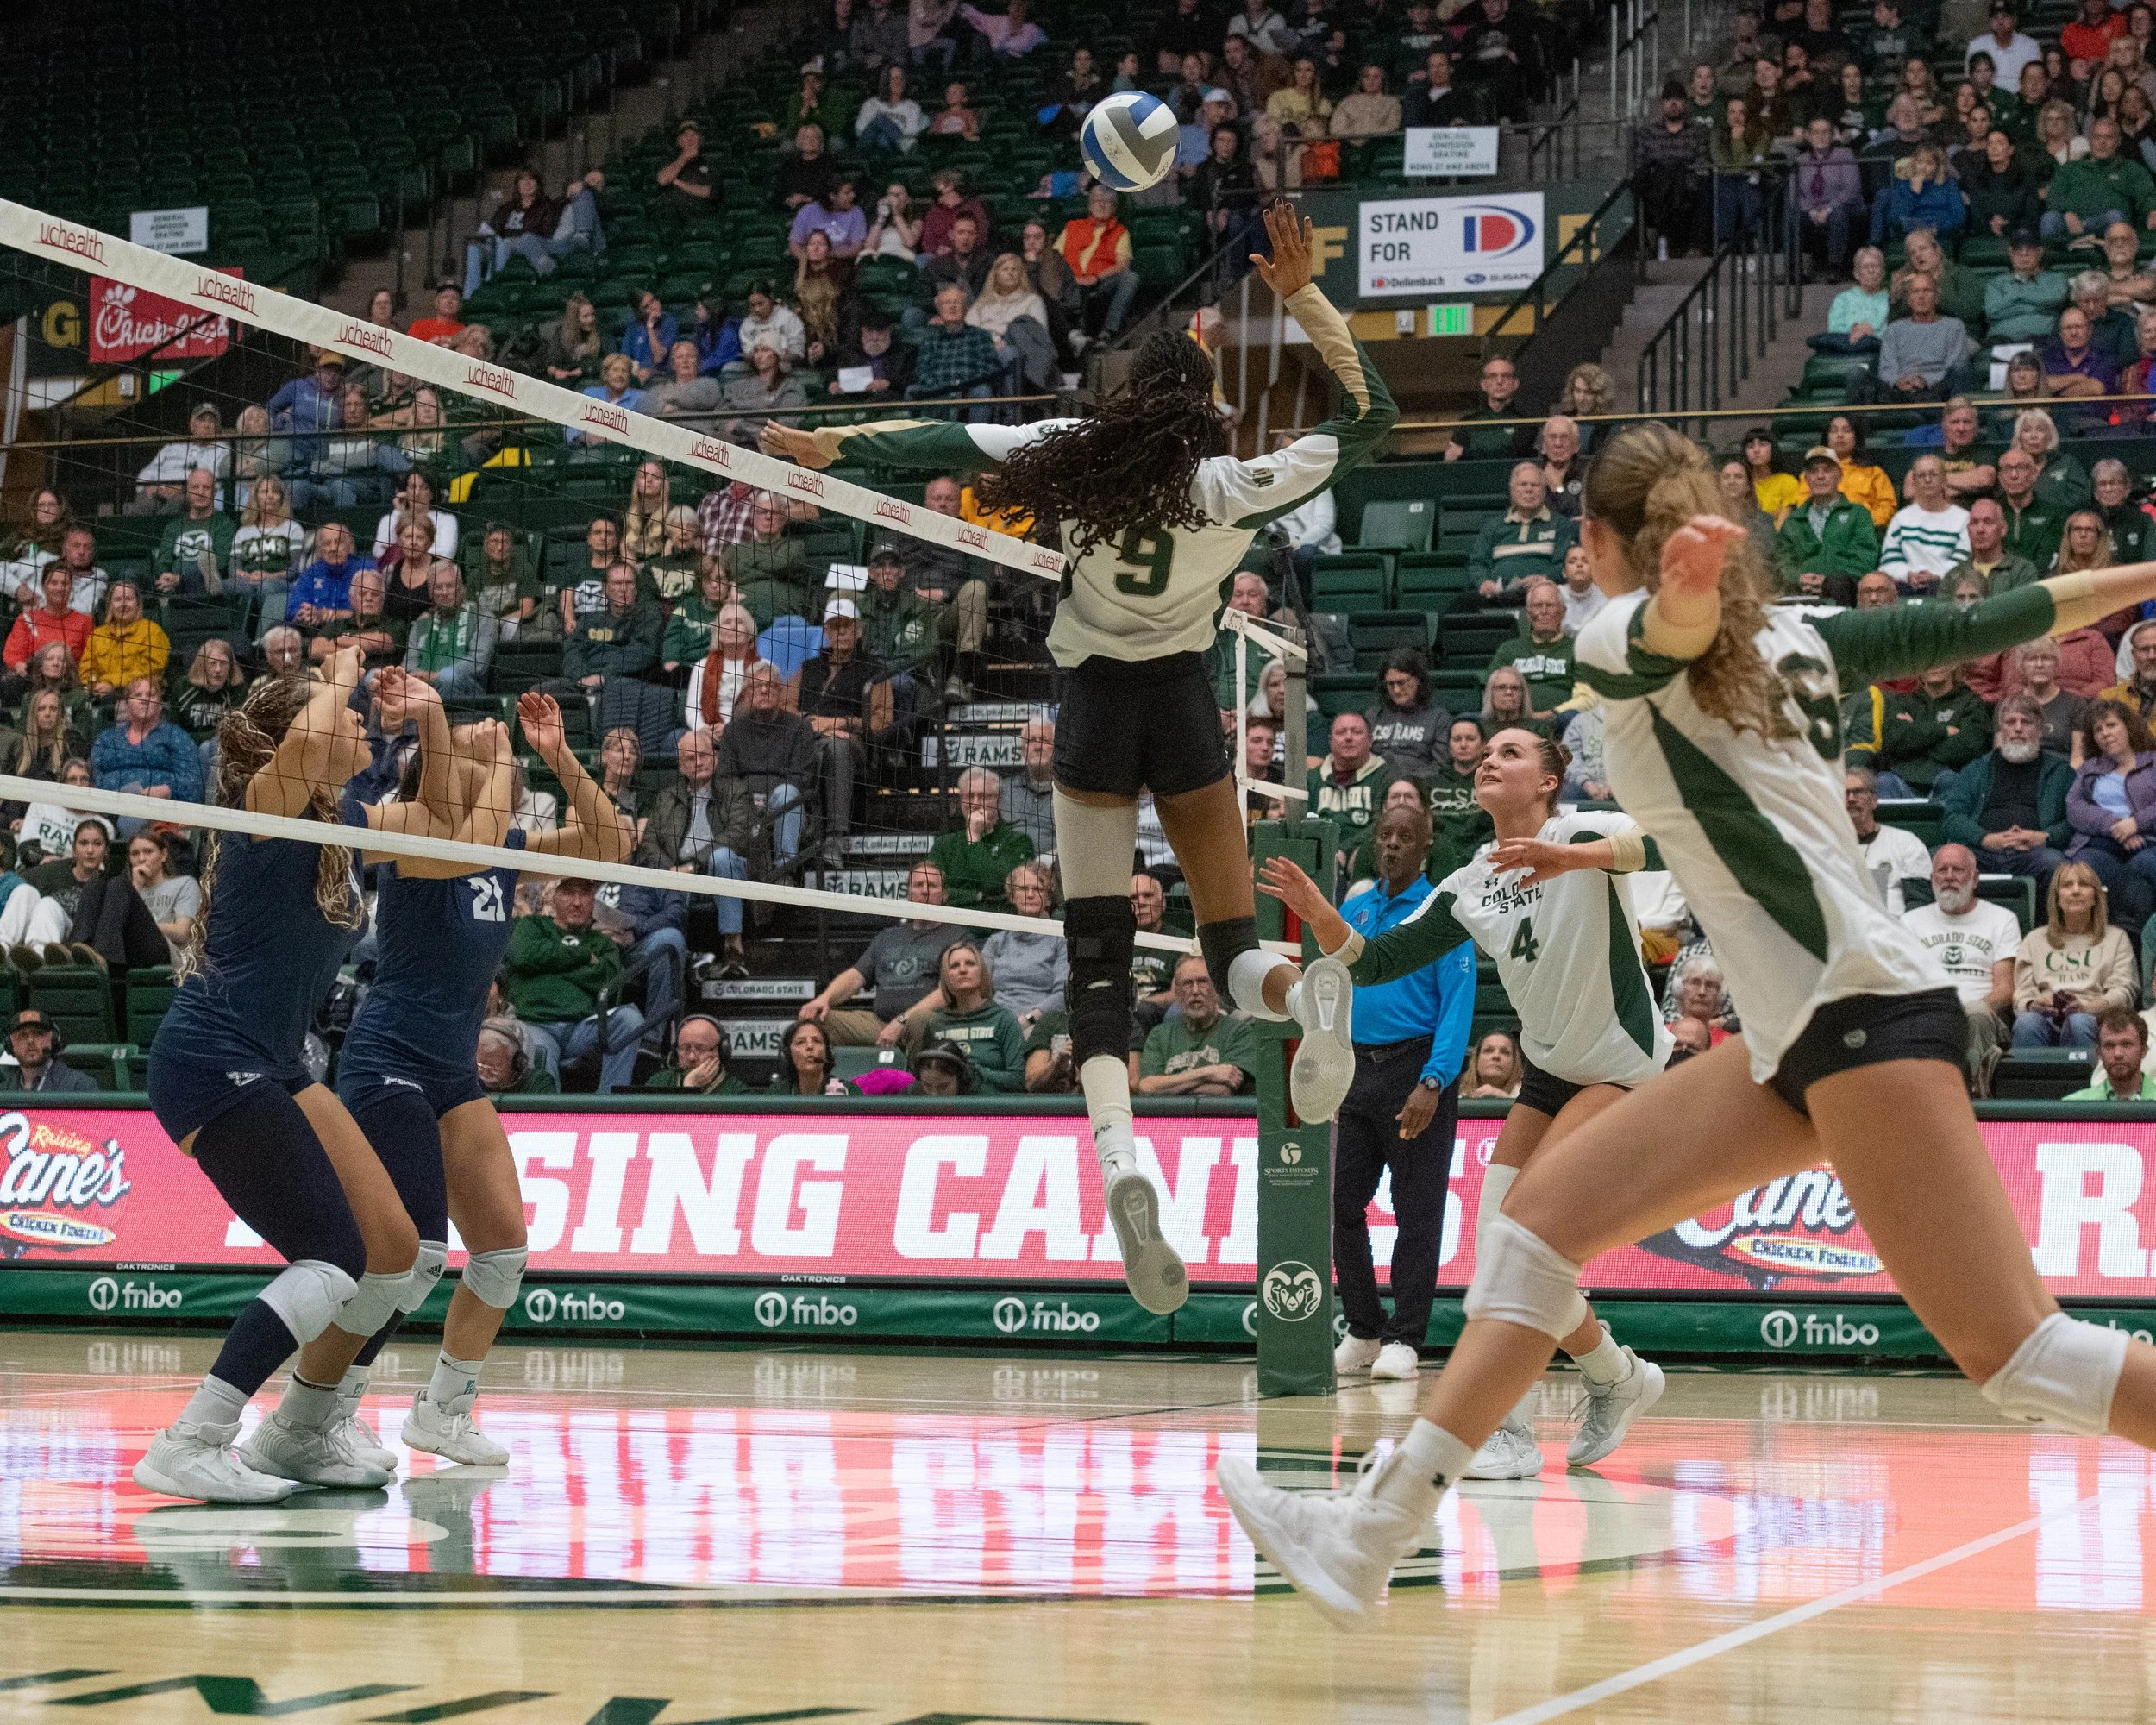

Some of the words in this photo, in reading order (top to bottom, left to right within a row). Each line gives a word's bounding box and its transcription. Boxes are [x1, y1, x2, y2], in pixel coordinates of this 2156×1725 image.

[1371, 211, 1438, 233] STAND
[41, 220, 103, 260] uchealth
[1311, 226, 1348, 275] F
[1371, 242, 1411, 262] FOR
[197, 273, 255, 312] uchealth
[44, 301, 81, 348] G
[339, 320, 392, 355] uchealth
[468, 361, 515, 398] uchealth
[586, 401, 628, 432] uchealth
[691, 436, 730, 467] uchealth
[787, 467, 824, 496] uchealth
[876, 497, 911, 524] uchealth
[957, 524, 988, 550] uchealth
[1033, 549, 1063, 574] uchealth
[1113, 522, 1175, 598] 9
[1394, 721, 1426, 743] RAMS
[964, 746, 1022, 762] RAMS
[467, 875, 506, 922] 21
[849, 881, 907, 899] RAMS
[1499, 888, 1542, 914] STATE
[1510, 916, 1539, 963] 4
[1921, 932, 1965, 950] OLORADO
[1966, 935, 1995, 955] STATE
[726, 985, 774, 994] COLORADO
[775, 985, 805, 994] STATE
[734, 1032, 781, 1051] AMS
[30, 1125, 91, 1158] Raising
[1264, 1167, 1288, 1176] SPORTS
[1289, 1167, 1319, 1176] IMPORTS
[116, 1262, 175, 1271] DAKTRONICS
[781, 1274, 846, 1284] DAKTRONICS
[122, 1281, 183, 1309] fnbo
[561, 1292, 625, 1321] fnbo
[791, 1295, 858, 1327] fnbo
[1031, 1302, 1100, 1333] fnbo
[1803, 1314, 1880, 1346] fnbo
